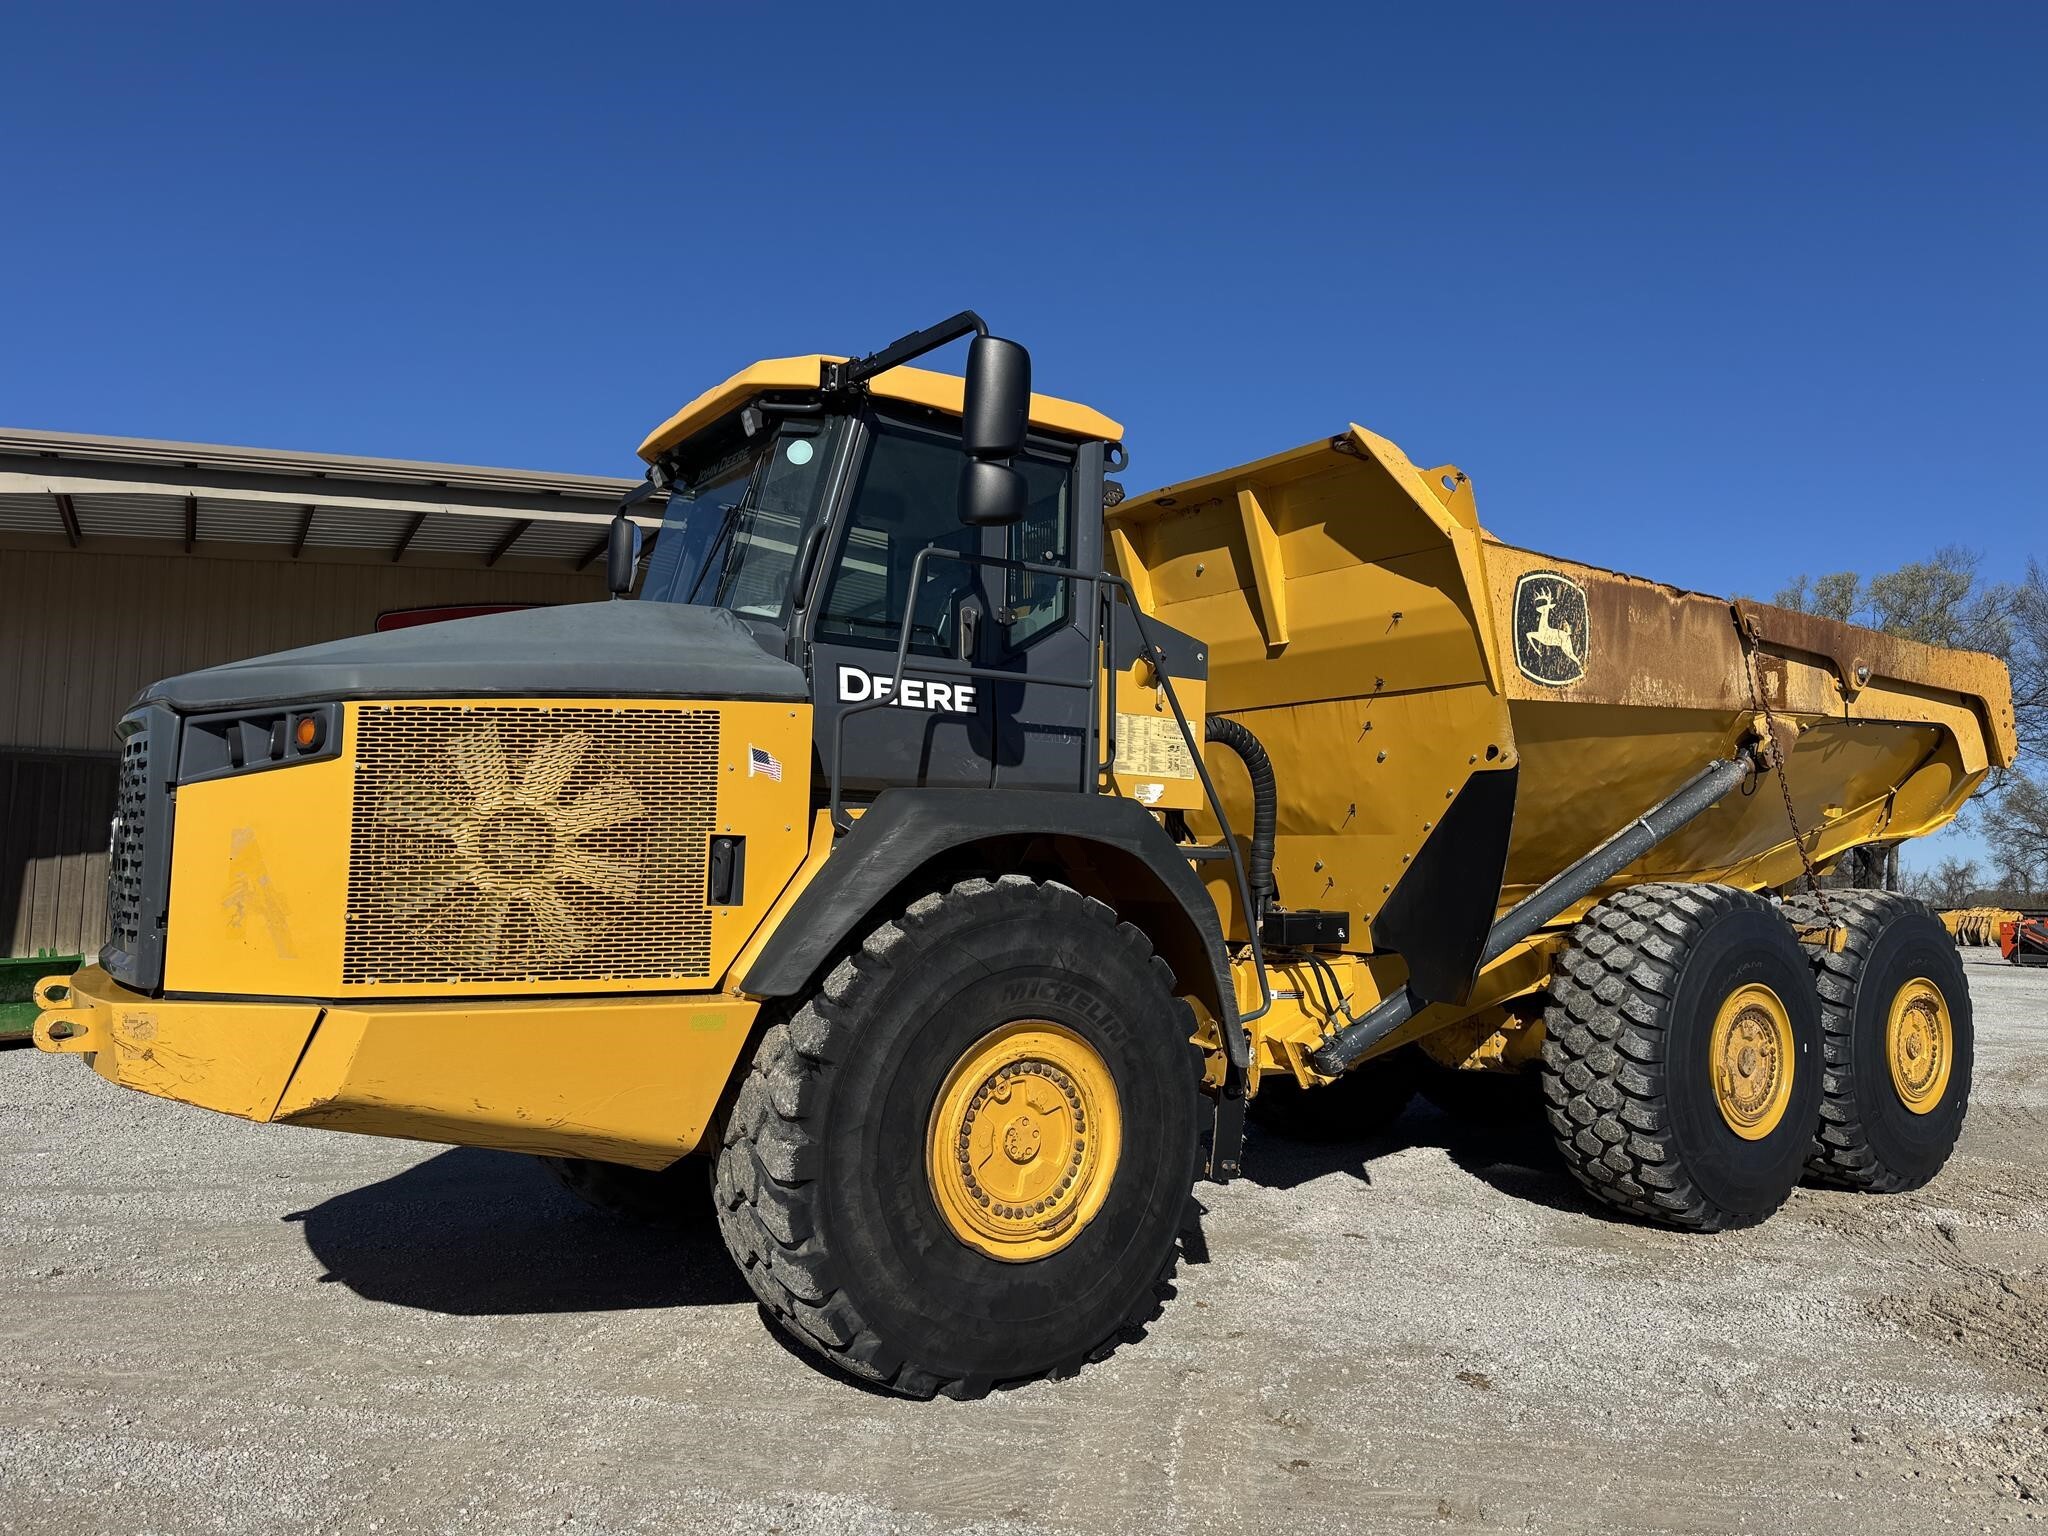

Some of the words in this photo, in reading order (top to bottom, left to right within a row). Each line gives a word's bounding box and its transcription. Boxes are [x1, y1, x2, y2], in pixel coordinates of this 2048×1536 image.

[719, 446, 752, 473] DEERE
[839, 666, 977, 713] DEERE
[1001, 981, 1128, 1053] MICHELIN
